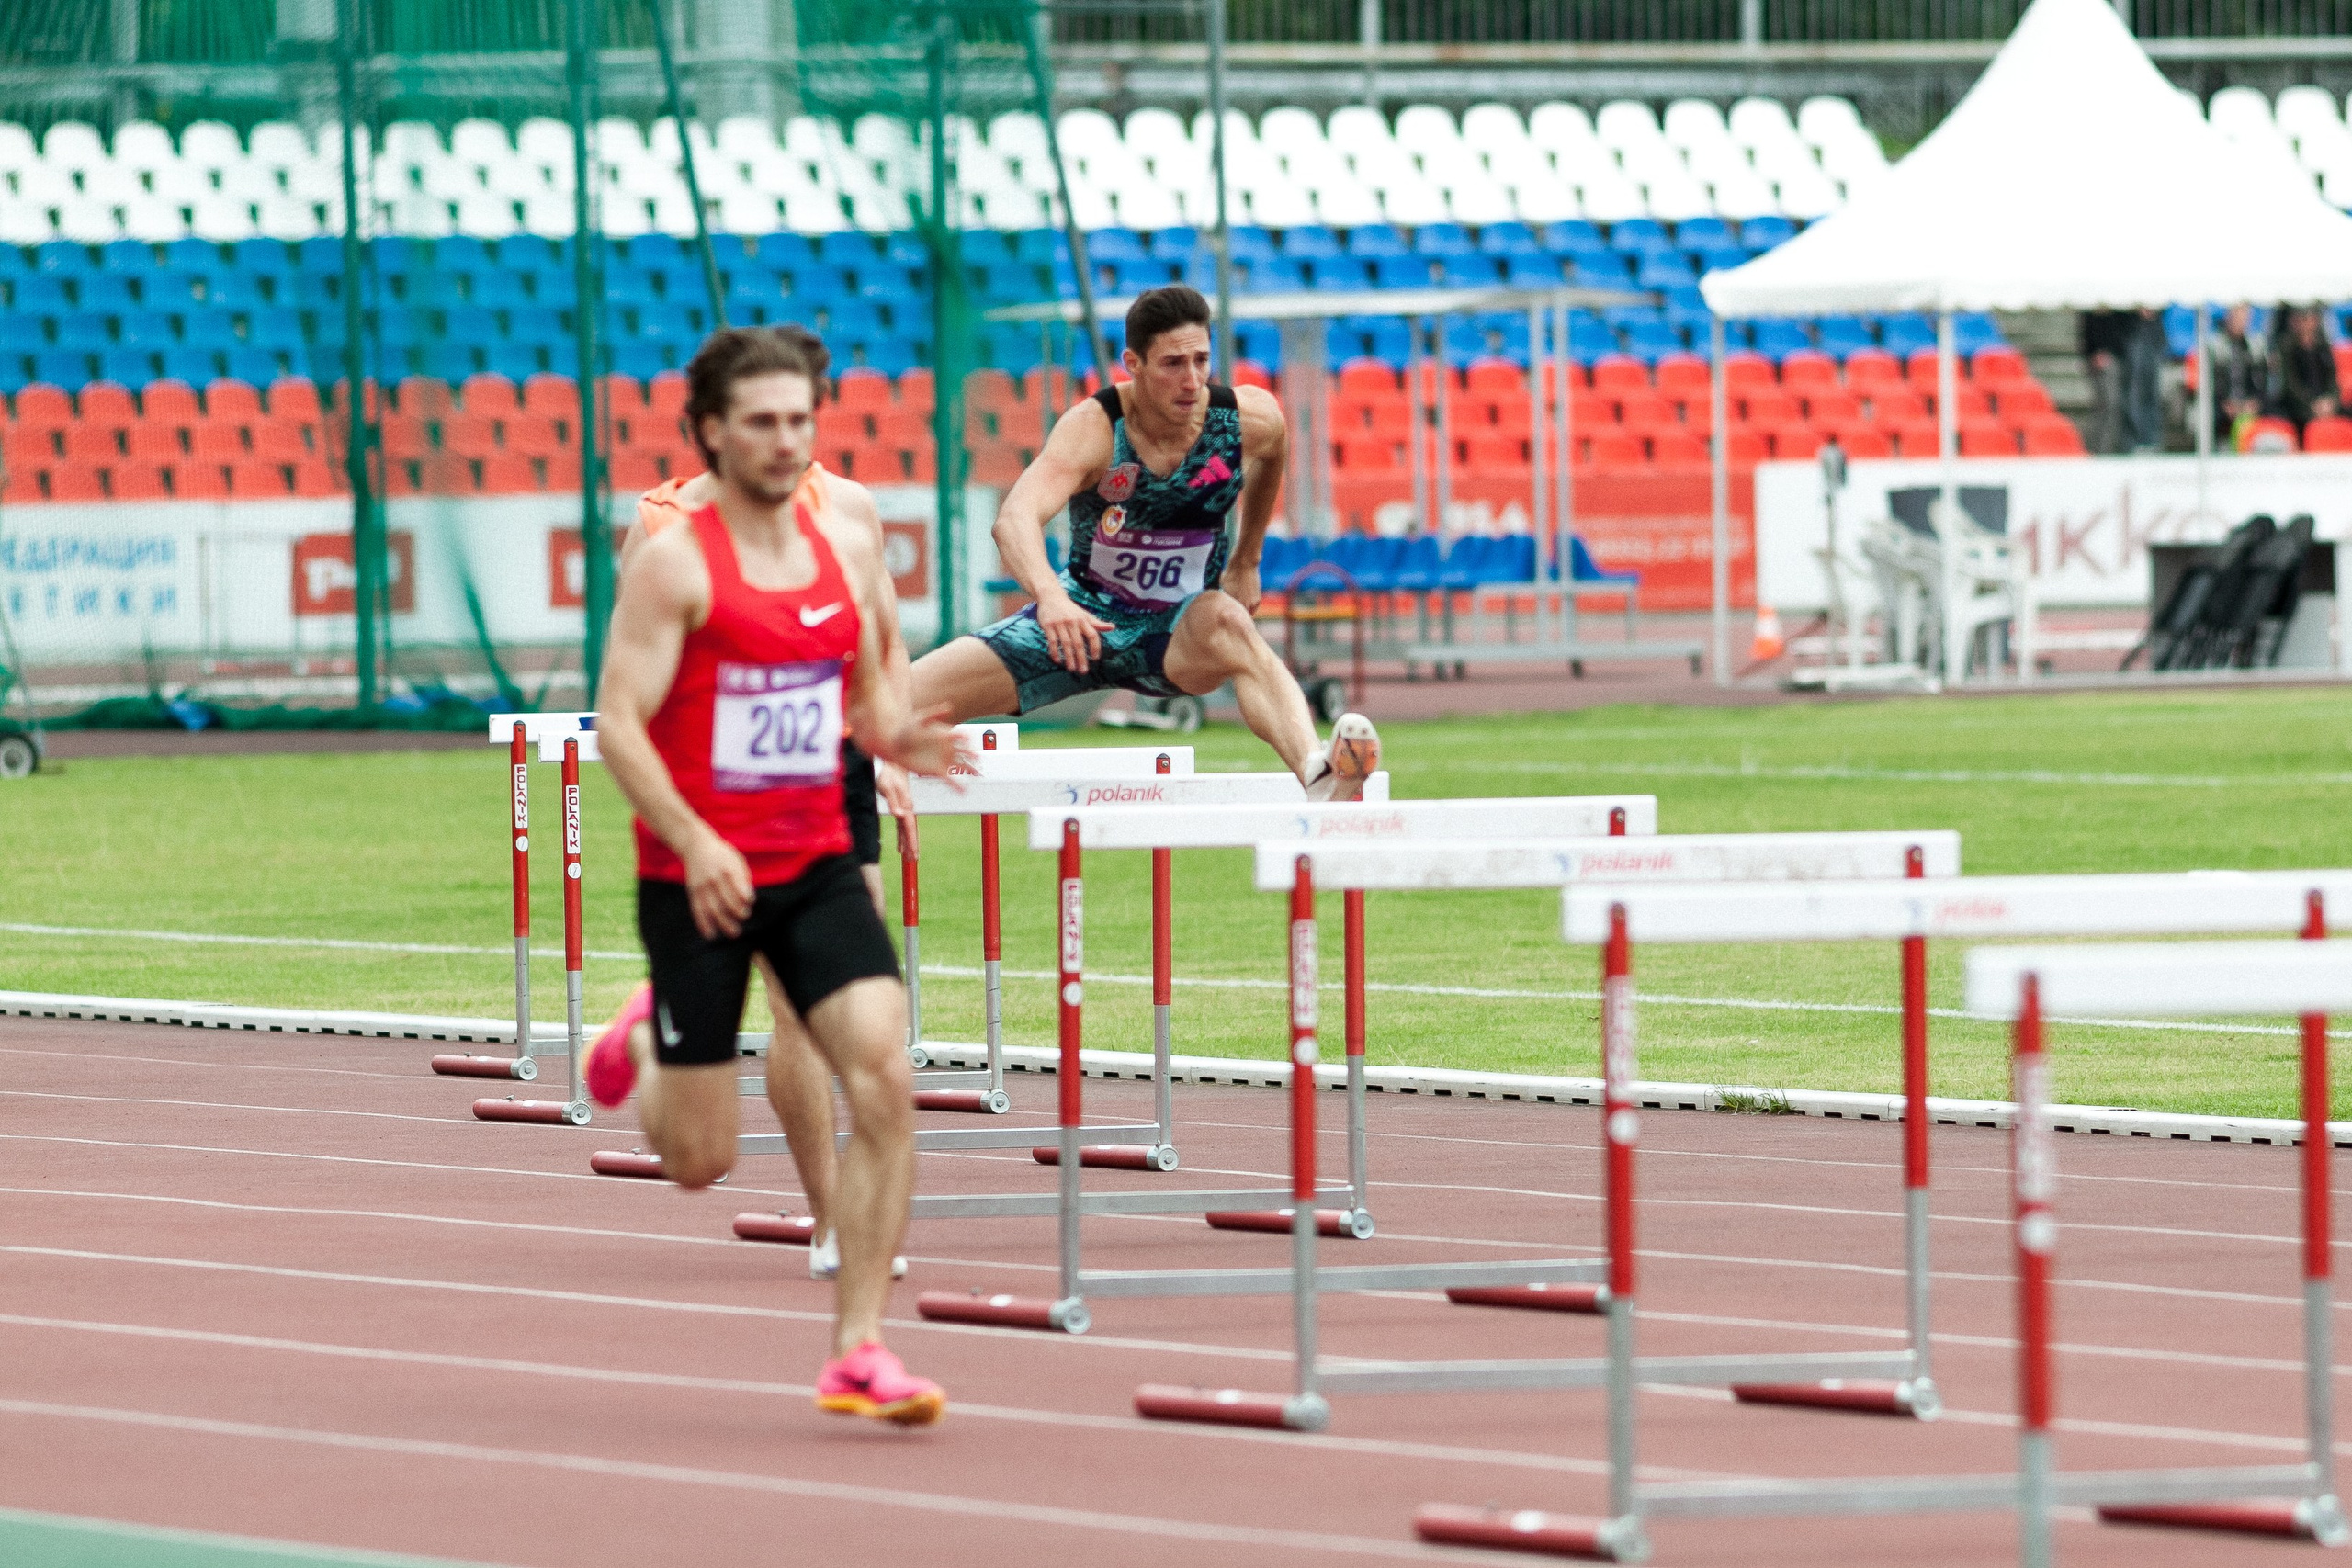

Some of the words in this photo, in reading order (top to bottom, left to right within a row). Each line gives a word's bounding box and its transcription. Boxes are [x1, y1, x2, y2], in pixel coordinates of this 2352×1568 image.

[1113, 552, 1185, 590] 266
[750, 700, 823, 757] 202
[516, 766, 526, 822] POLANIK
[568, 787, 579, 848] POLANIK
[1087, 782, 1165, 806] polanik
